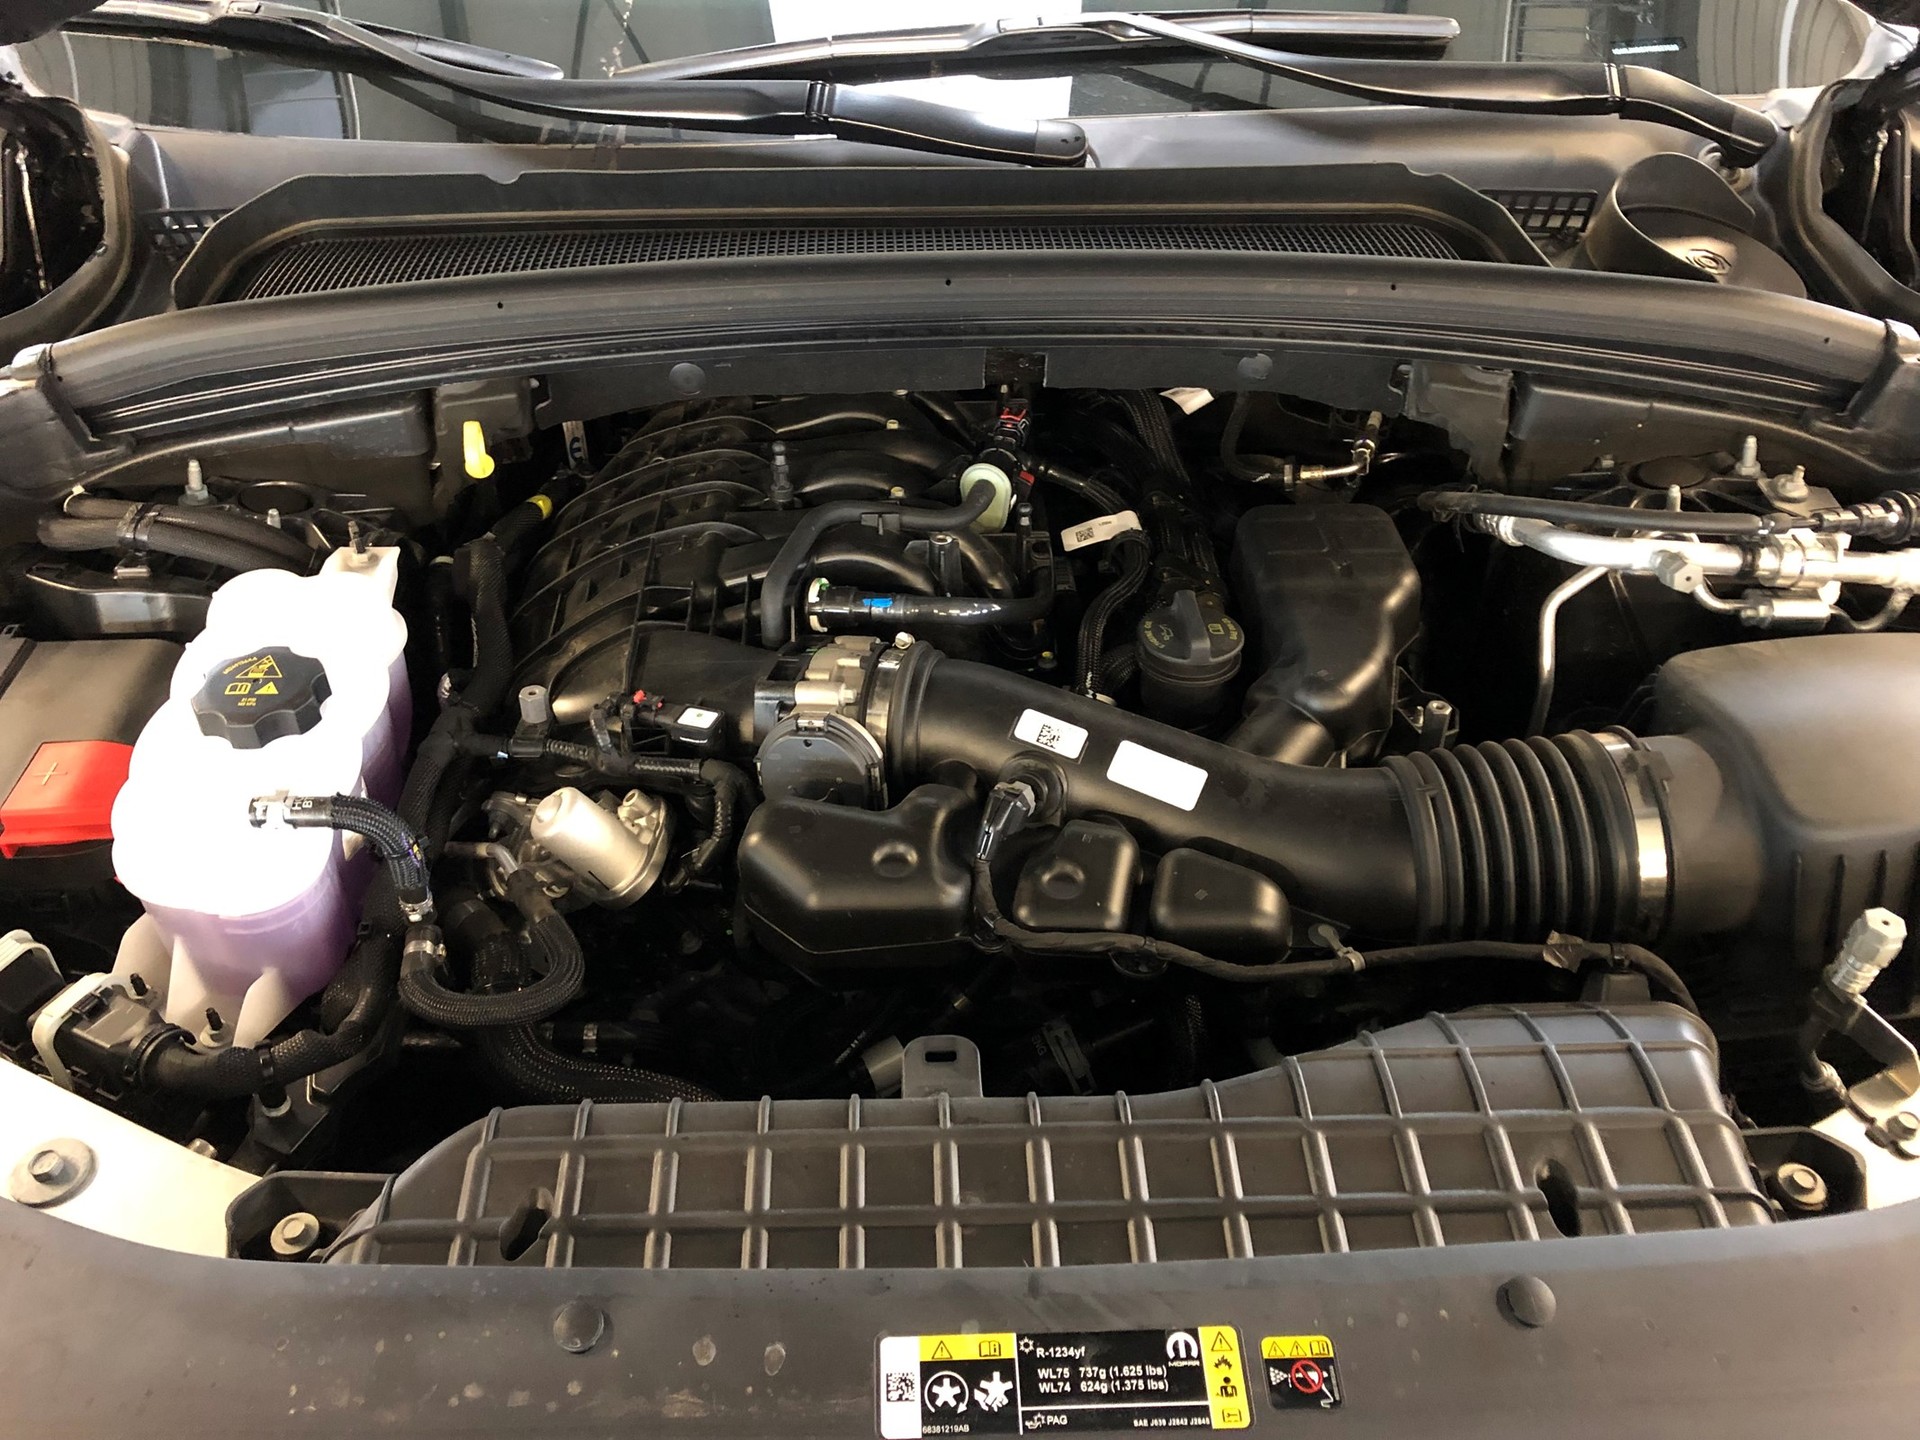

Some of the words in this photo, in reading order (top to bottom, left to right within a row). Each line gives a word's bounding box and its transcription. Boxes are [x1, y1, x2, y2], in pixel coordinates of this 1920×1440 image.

[1036, 1346, 1086, 1359] R-1234yf
[1038, 1367, 1070, 1380] WL75
[1079, 1366, 1107, 1380] 737g
[1109, 1365, 1143, 1379] (1.625
[1145, 1364, 1168, 1378] lbs)
[1039, 1381, 1071, 1394] WL74
[1080, 1380, 1108, 1394] 624g
[1111, 1379, 1145, 1393] (1.375
[1147, 1378, 1169, 1392] lbs)
[1046, 1414, 1068, 1425] PAG
[922, 1424, 970, 1434] 68381219AB
